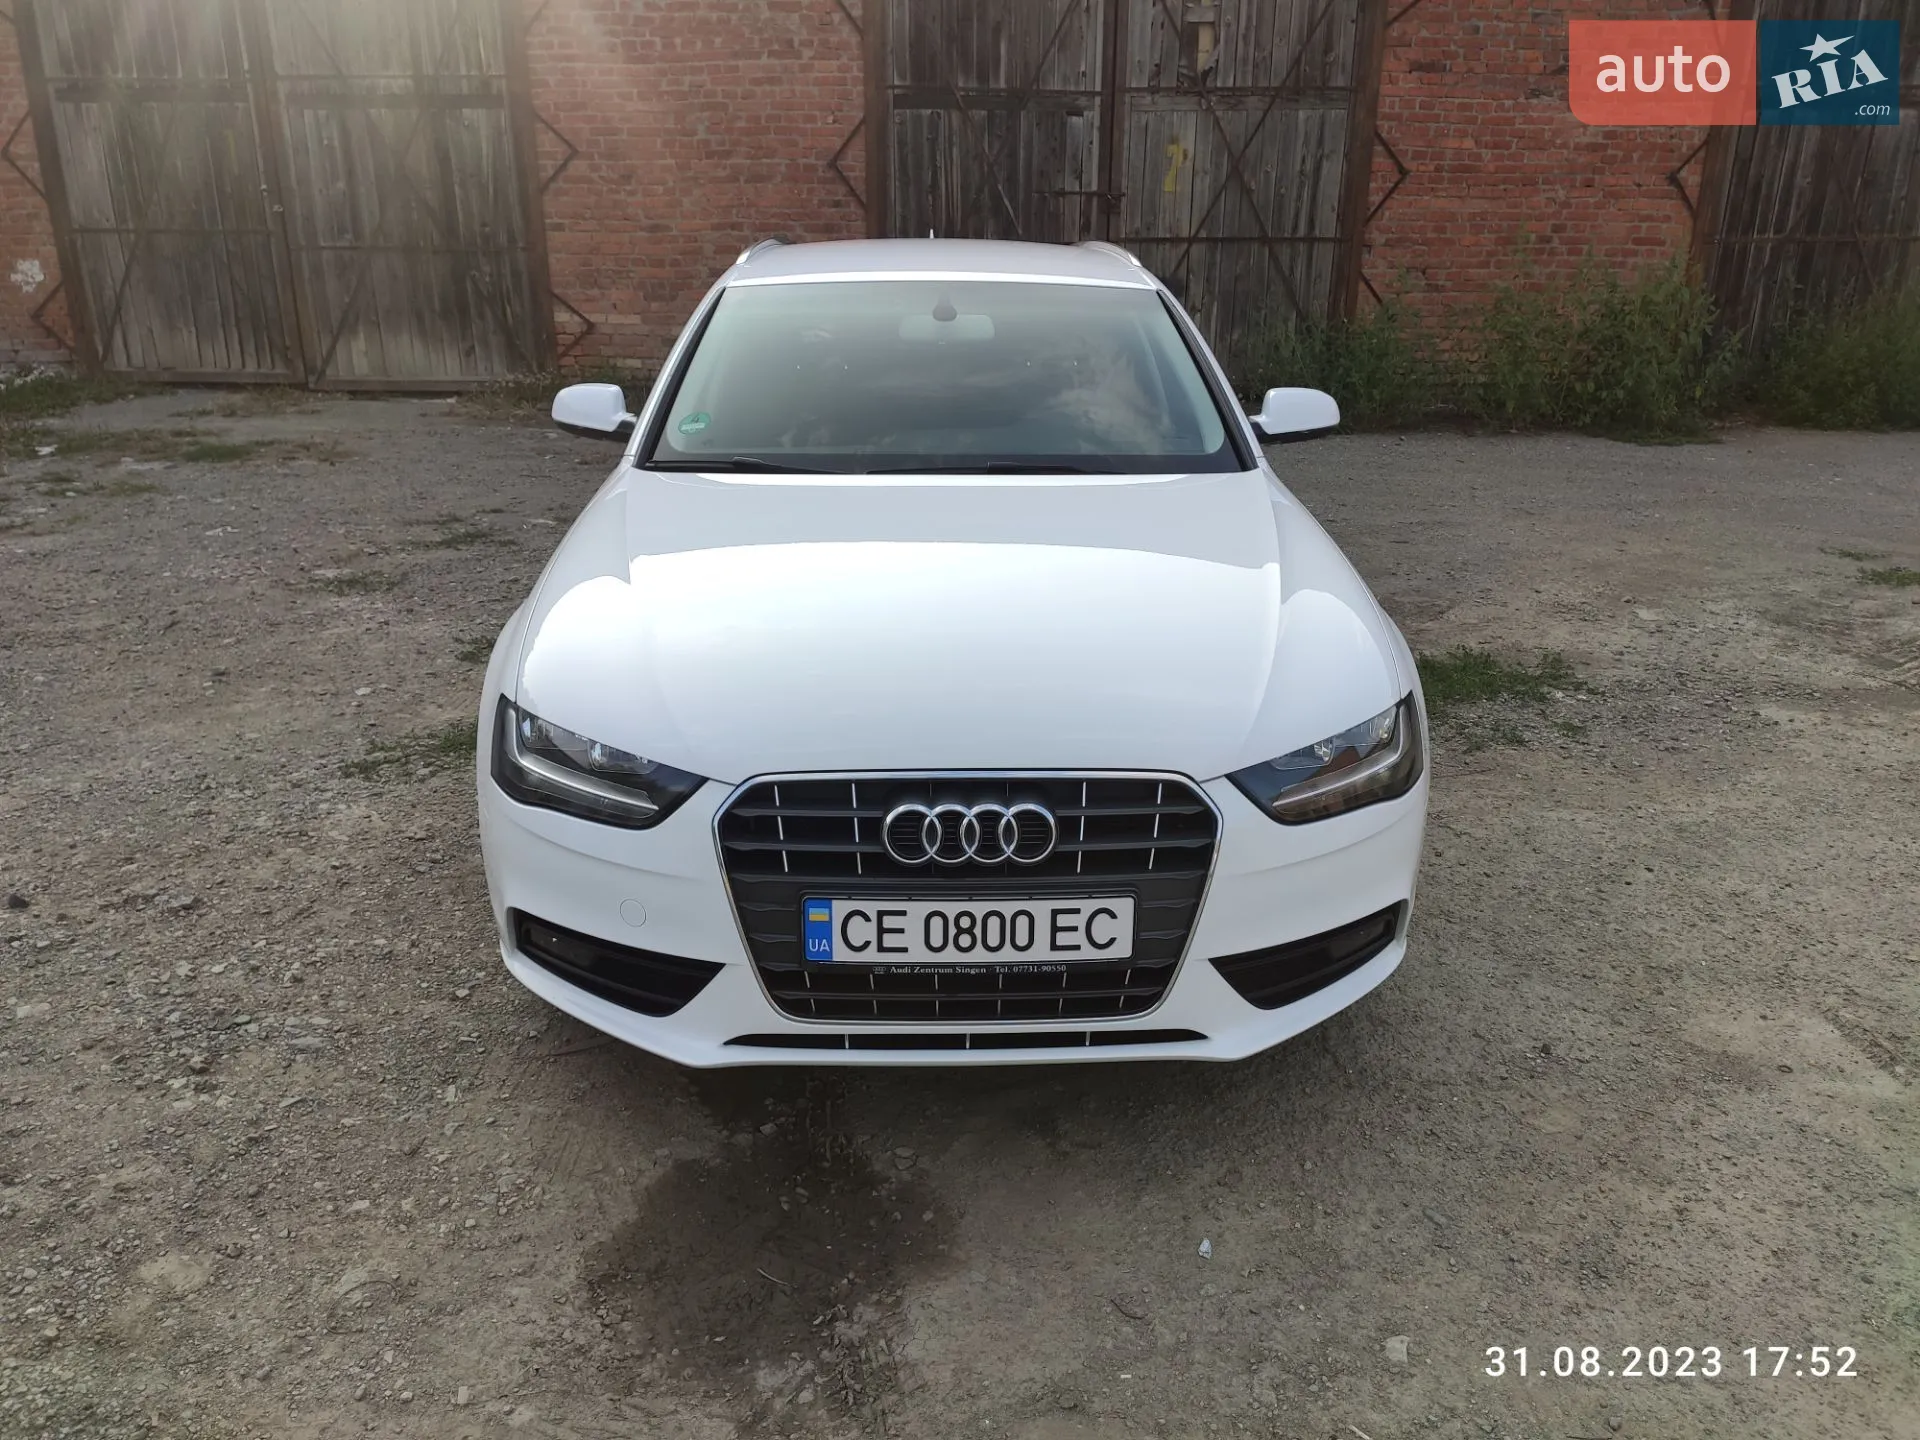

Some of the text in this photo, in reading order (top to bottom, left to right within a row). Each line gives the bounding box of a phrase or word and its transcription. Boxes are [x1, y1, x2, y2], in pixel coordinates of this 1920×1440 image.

[840, 907, 1119, 953] CE 0800 EC
[808, 938, 830, 952] UA
[889, 965, 912, 974] Audi
[913, 966, 953, 974] Zentrum
[955, 966, 987, 975] Singen
